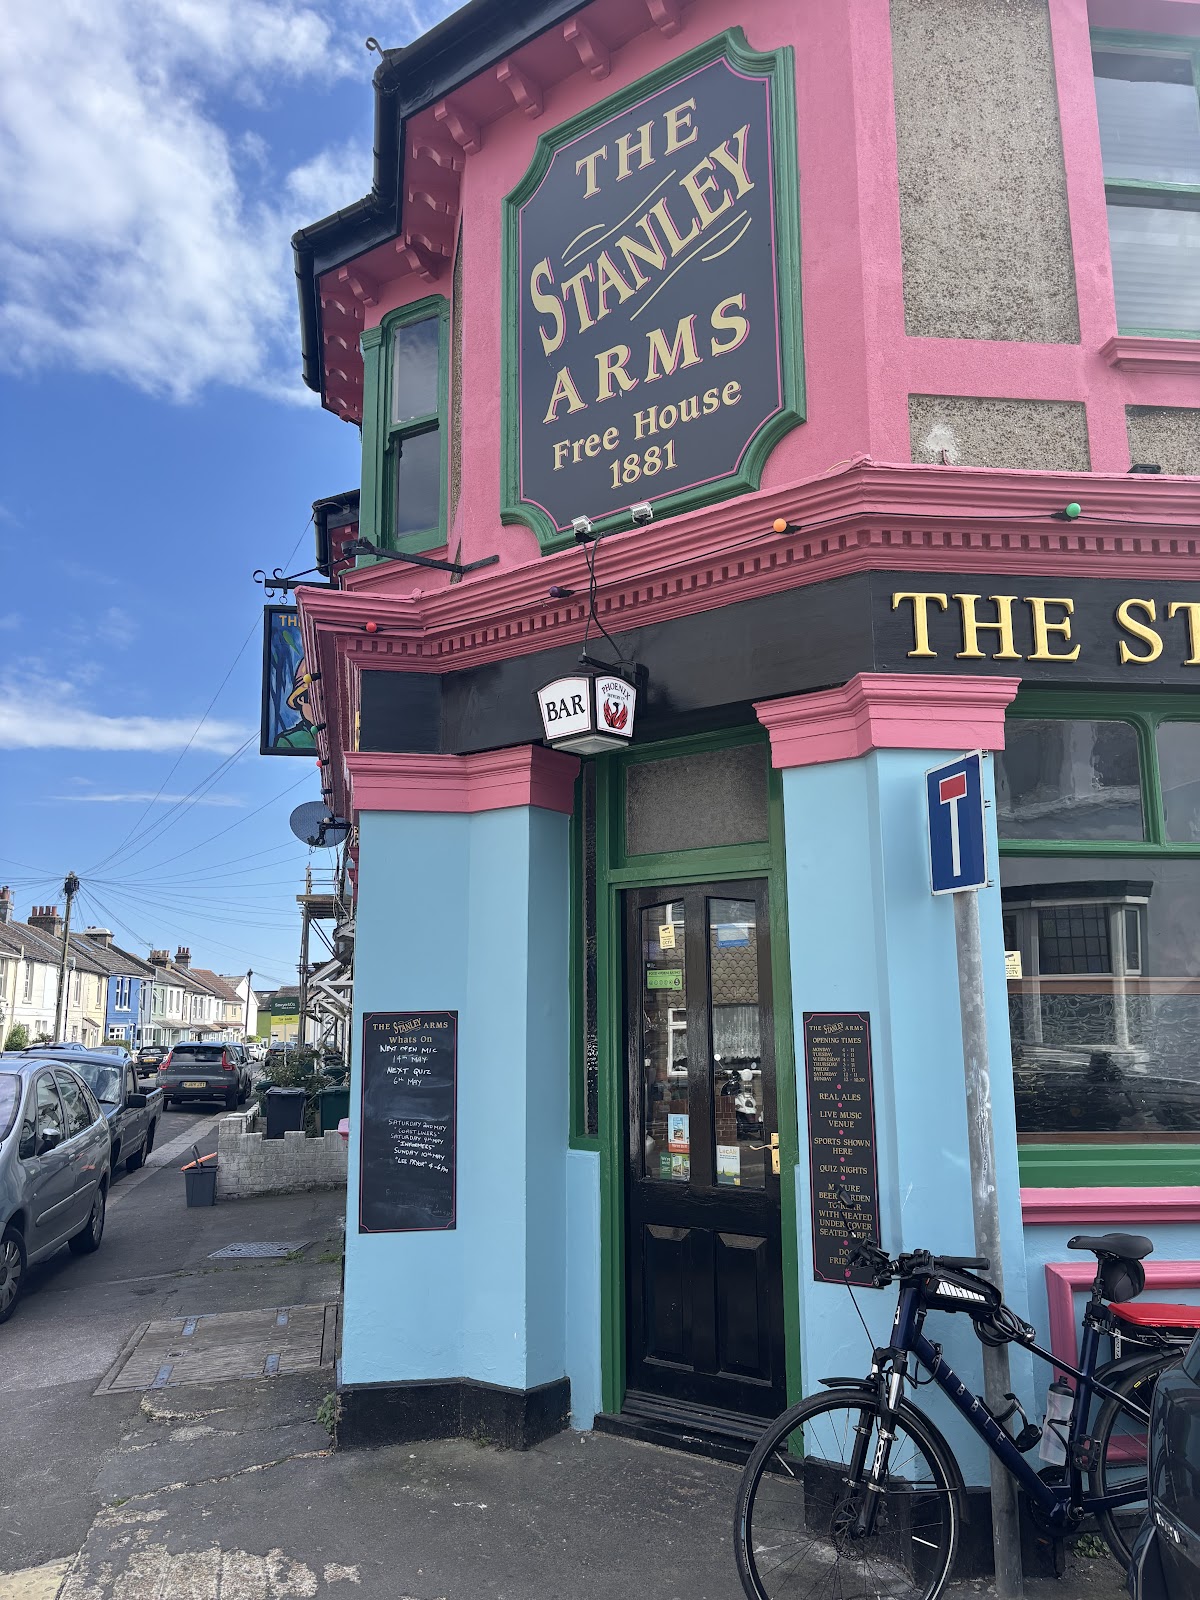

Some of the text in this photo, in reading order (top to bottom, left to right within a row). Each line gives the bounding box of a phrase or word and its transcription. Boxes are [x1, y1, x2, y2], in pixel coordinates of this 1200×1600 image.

[575, 96, 699, 200] THE
[530, 123, 756, 358] STANLEY
[542, 292, 751, 424] ARMS
[552, 380, 742, 472] Free House
[608, 438, 678, 490] 1881
[278, 615, 300, 627] TH
[892, 592, 1082, 662] THE
[602, 682, 630, 701] PHOENIX
[545, 694, 586, 722] BAR
[392, 1018, 421, 1034] STANLEY
[413, 1068, 431, 1077] QUIZ
[388, 1119, 421, 1128] SATURDAY
[391, 1133, 421, 1141] SATURDAY
[394, 1147, 418, 1156] SUNDAY
[840, 1166, 867, 1174] NIGHTS
[819, 1192, 838, 1200] BEER
[819, 1210, 839, 1218] WITH
[820, 1219, 872, 1230] UNDER COVER
[820, 1229, 848, 1237] SEATED
